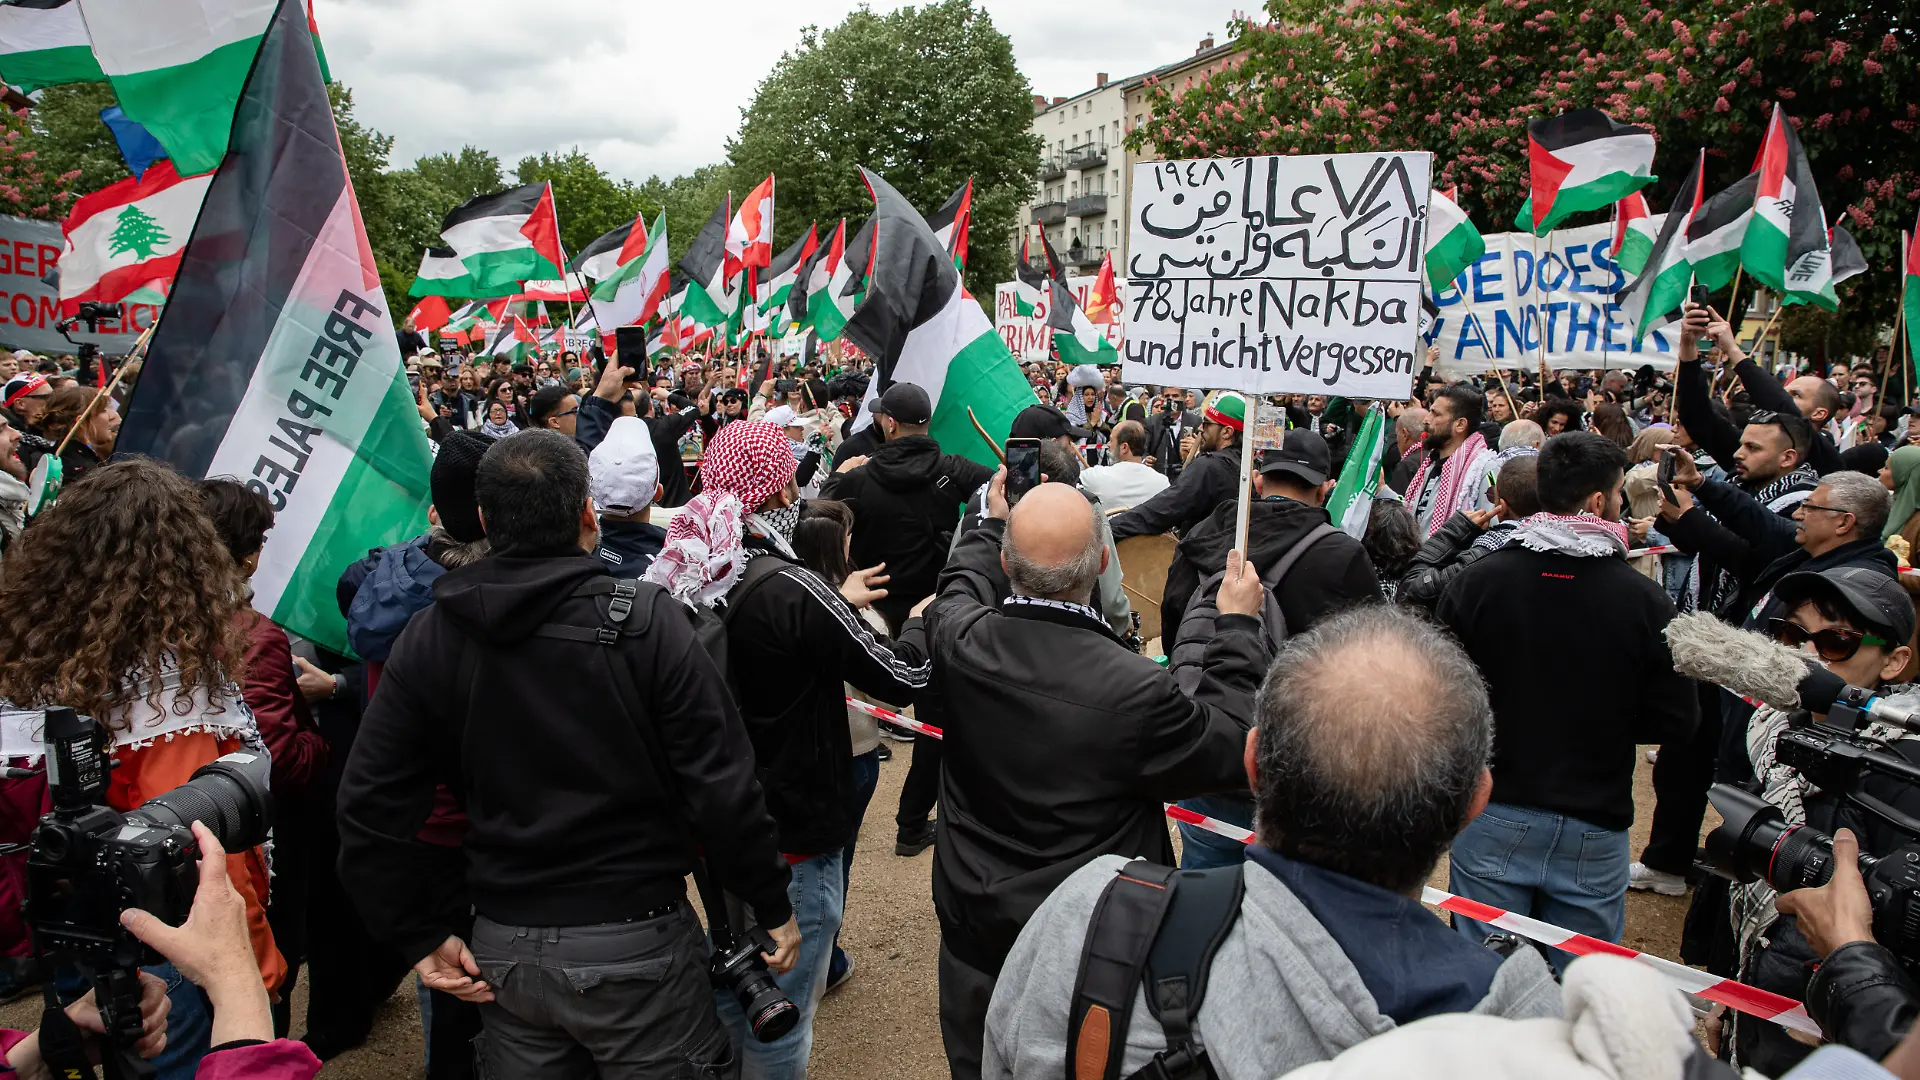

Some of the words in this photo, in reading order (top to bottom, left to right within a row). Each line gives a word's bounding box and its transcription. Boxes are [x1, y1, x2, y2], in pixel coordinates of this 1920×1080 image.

[1513, 238, 1626, 296] DOES
[1128, 279, 1172, 322] 78
[1172, 279, 1253, 320] Jahre
[1259, 279, 1407, 333] Nakba
[1125, 319, 1185, 369] und
[1191, 322, 1271, 372] nicht
[1275, 335, 1414, 386] Vergessen
